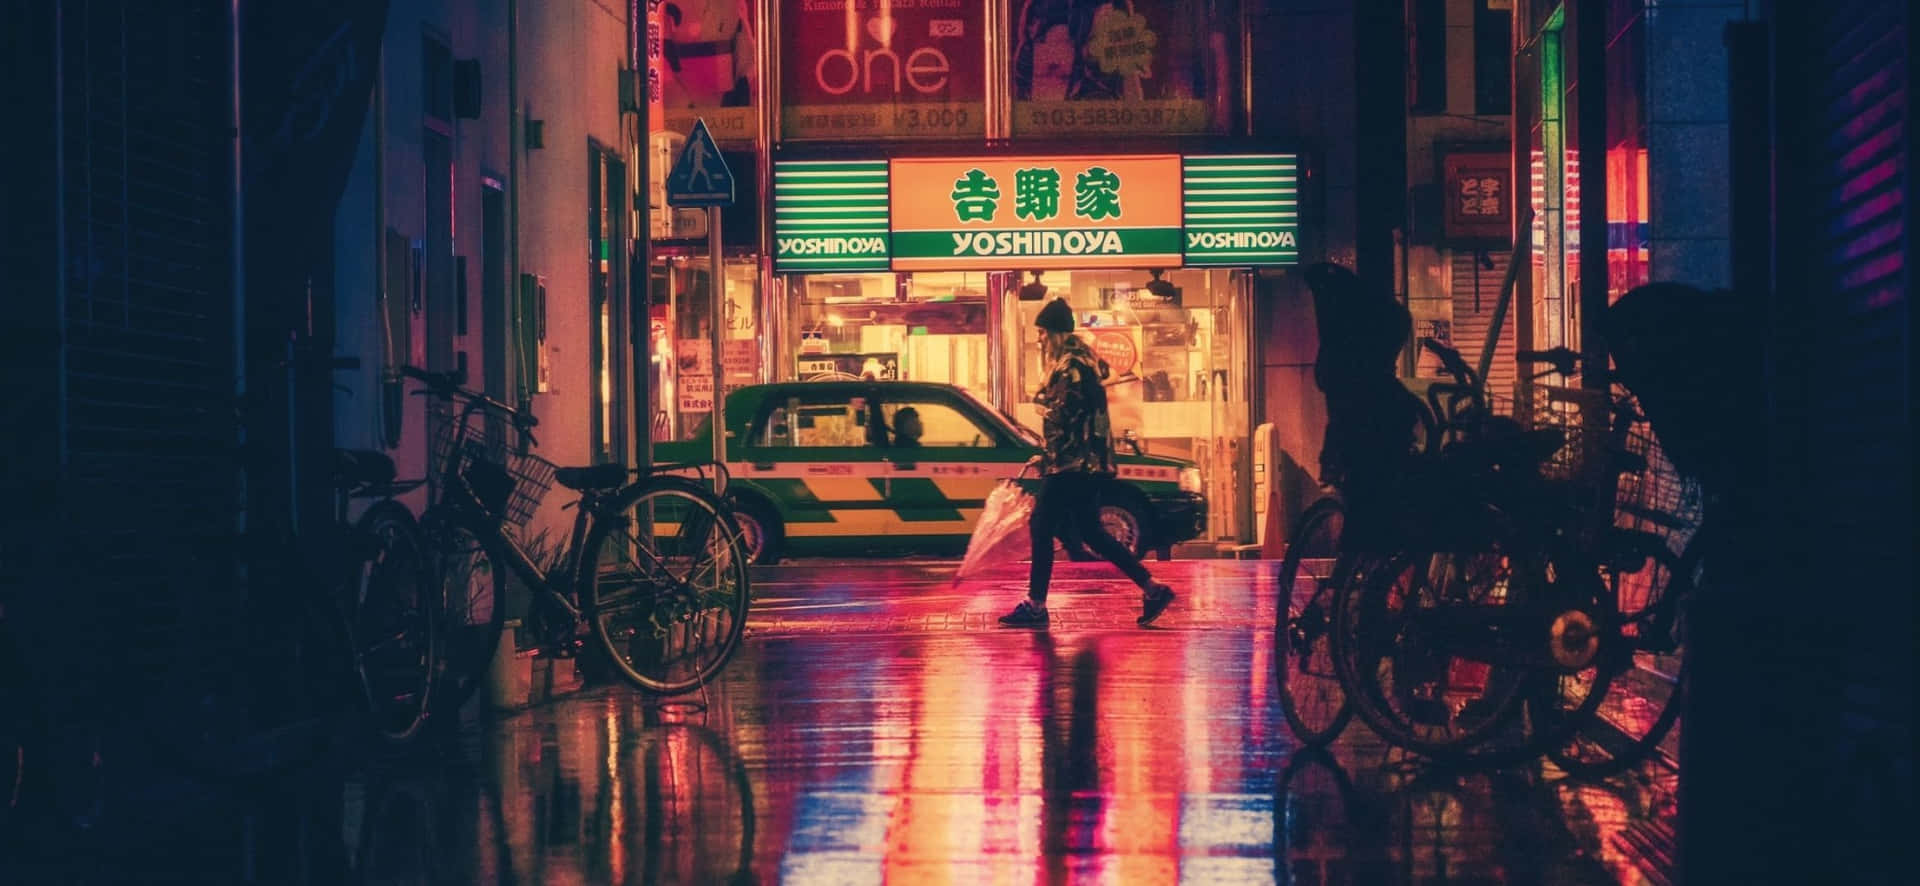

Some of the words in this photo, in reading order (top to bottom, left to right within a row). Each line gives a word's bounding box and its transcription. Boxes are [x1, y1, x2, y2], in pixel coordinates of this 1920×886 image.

[815, 47, 950, 95] one
[777, 237, 886, 254] YOSHINOYA
[951, 231, 1123, 255] YOSHINOYA
[1187, 231, 1296, 248] YOSHINOYA
